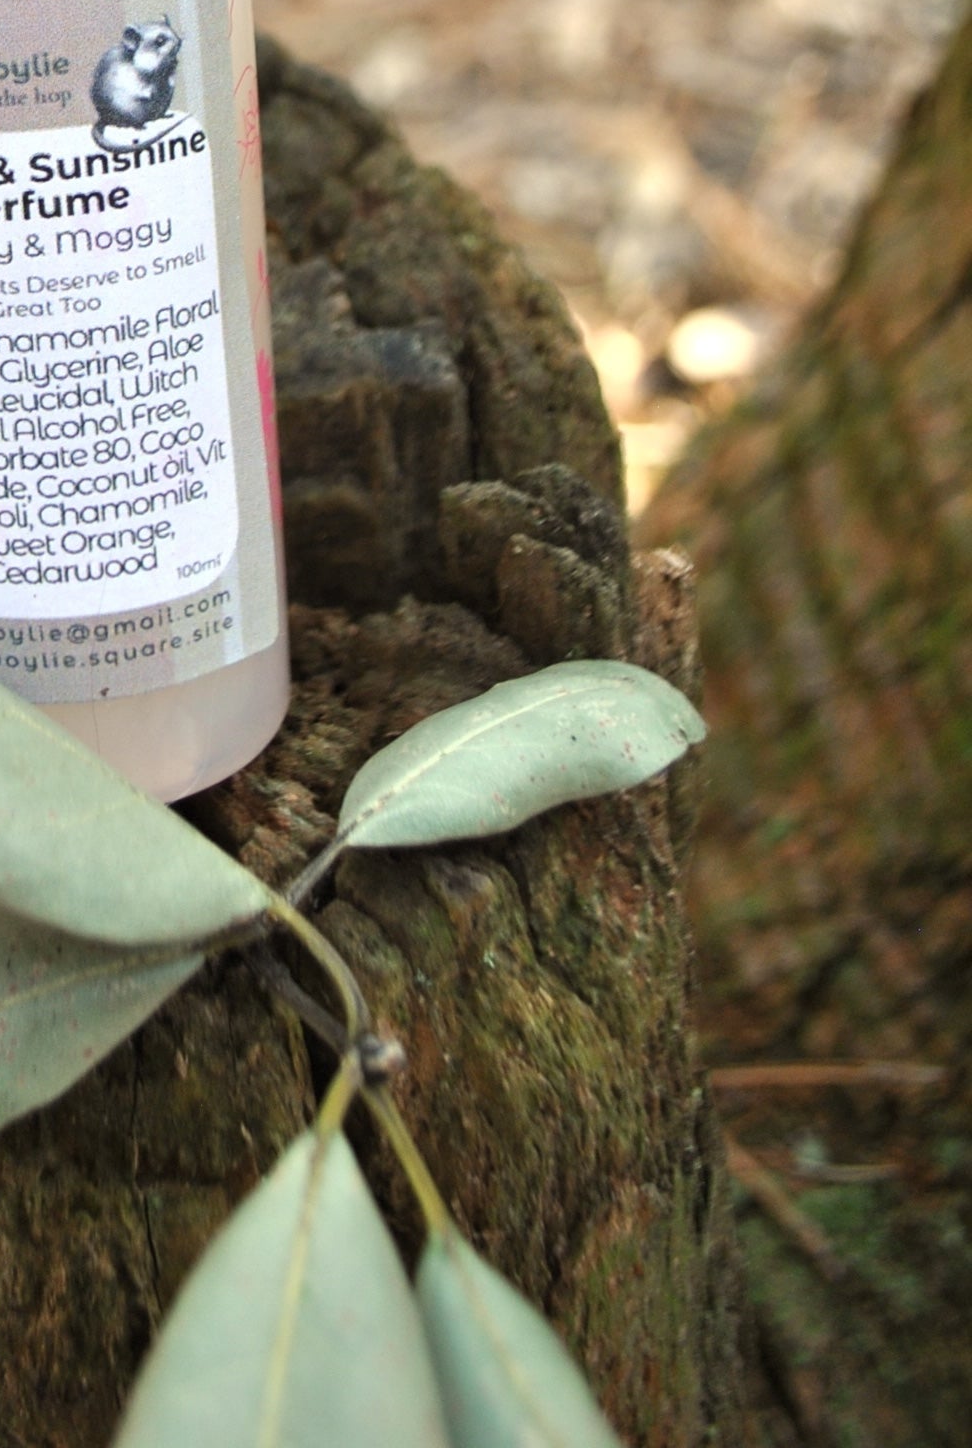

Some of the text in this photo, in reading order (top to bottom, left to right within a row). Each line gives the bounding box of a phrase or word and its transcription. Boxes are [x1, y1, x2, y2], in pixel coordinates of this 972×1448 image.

[34, 87, 72, 108] hop
[29, 130, 206, 183] Sunshine
[24, 233, 45, 257] &
[56, 217, 172, 254] Moggy
[27, 268, 119, 294] Deserve
[126, 264, 147, 281] to
[152, 244, 206, 275] Smell
[59, 296, 102, 314] Too
[155, 290, 219, 334] Floral
[0, 351, 144, 388] Glycerine,
[148, 333, 204, 365] Aloe
[121, 361, 198, 400] Witch
[13, 407, 127, 441] Alcohol
[132, 399, 191, 429] Free,
[93, 436, 137, 464] 80,
[140, 422, 204, 455] Coco
[37, 462, 159, 498] Coconut
[197, 438, 227, 466] Vit
[38, 478, 208, 528] Chamomile,
[61, 520, 175, 554] Orange,
